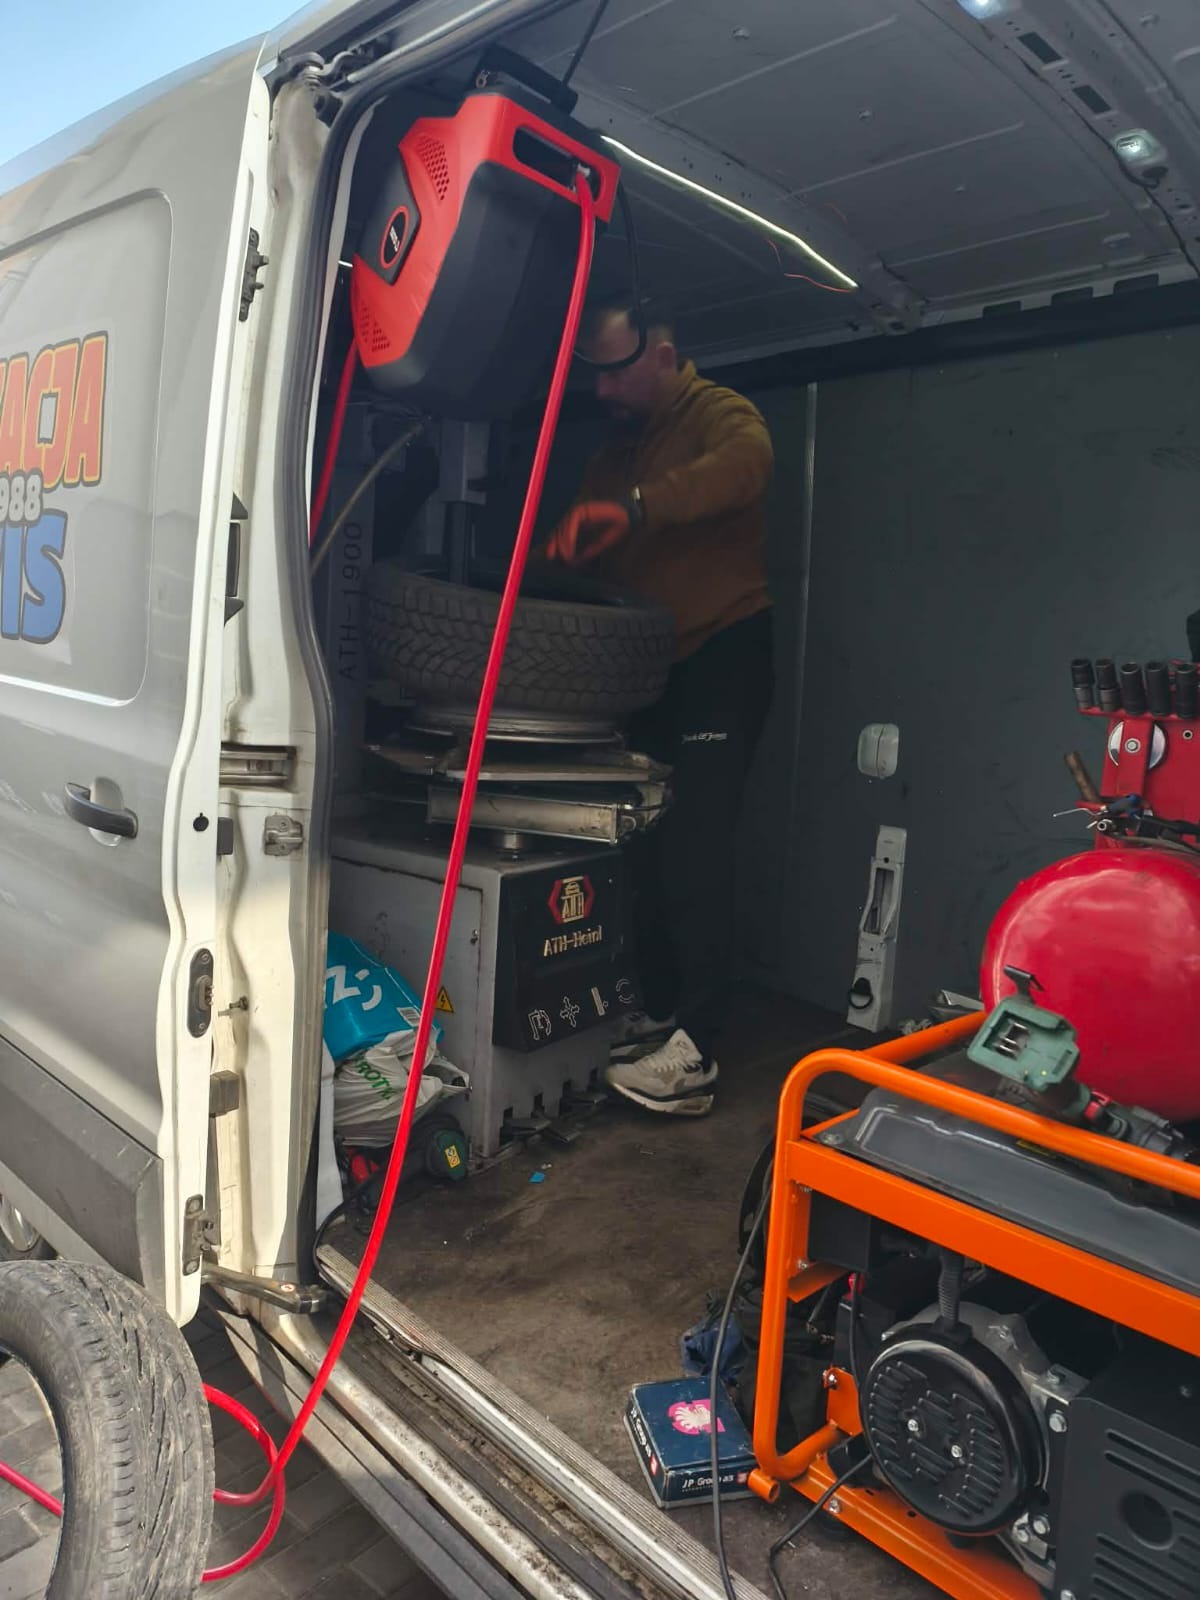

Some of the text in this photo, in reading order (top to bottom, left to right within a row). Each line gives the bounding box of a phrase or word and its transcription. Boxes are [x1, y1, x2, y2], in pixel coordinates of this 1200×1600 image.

[338, 521, 362, 680] ATH-1900
[543, 925, 603, 957] ATH-Heinl
[682, 1479, 695, 1489] JP
